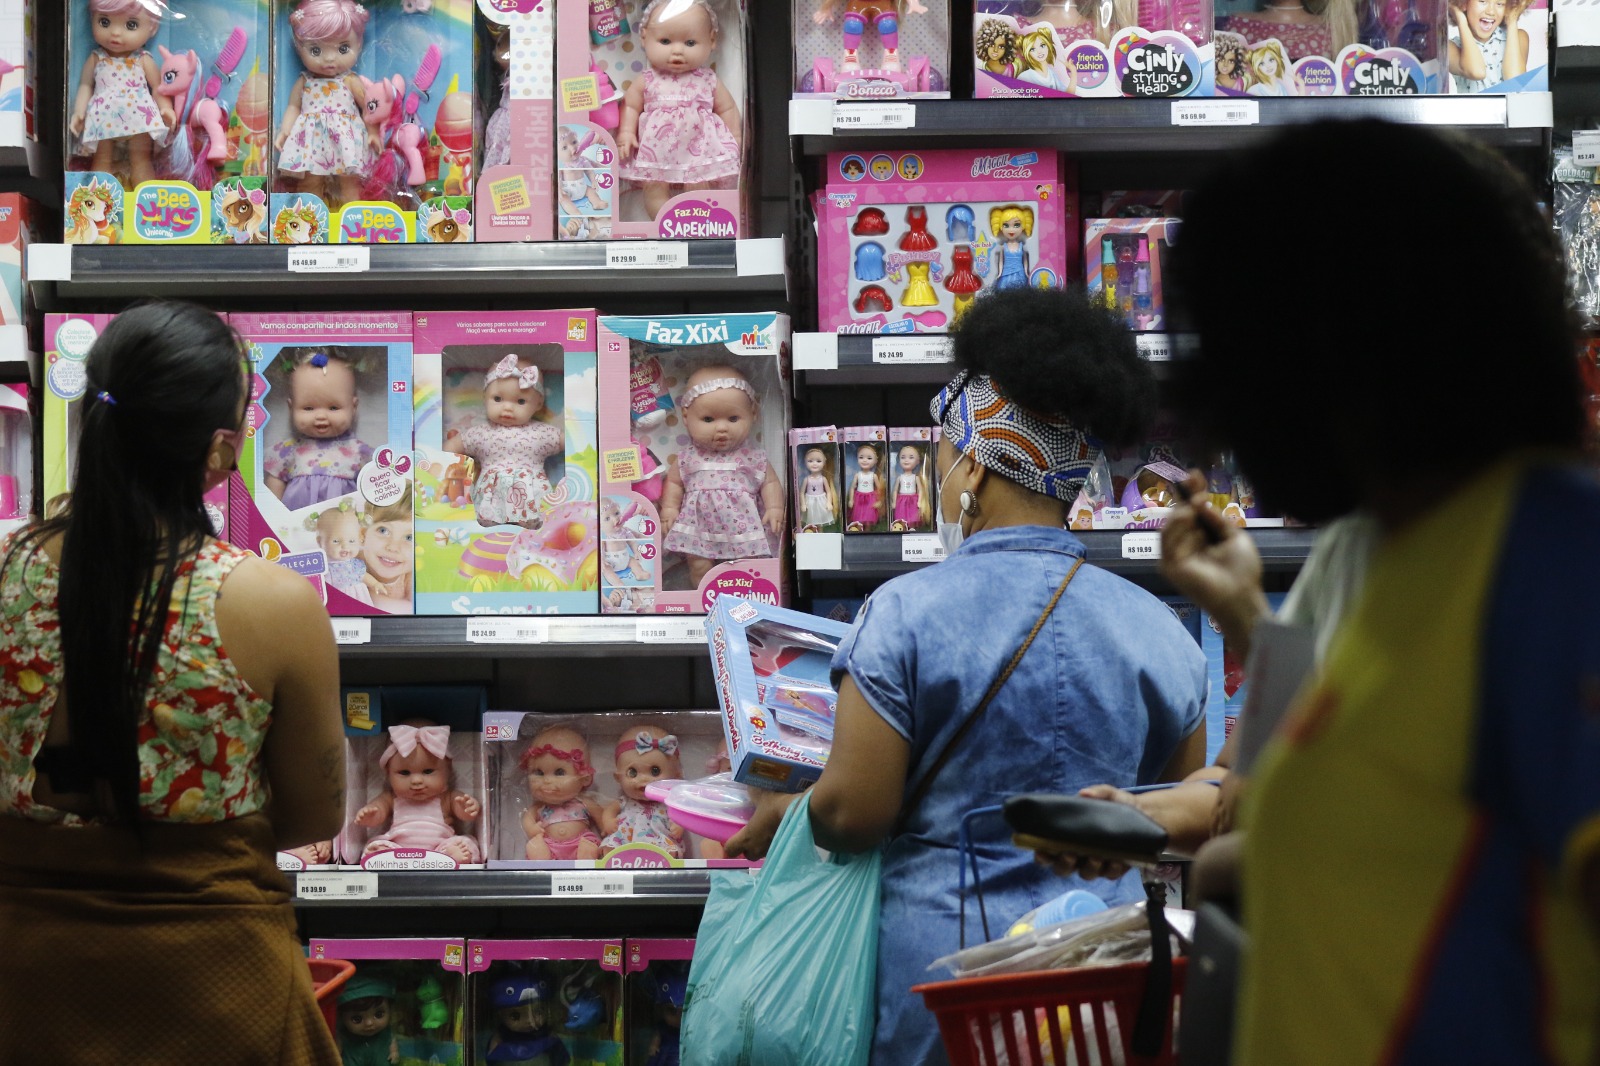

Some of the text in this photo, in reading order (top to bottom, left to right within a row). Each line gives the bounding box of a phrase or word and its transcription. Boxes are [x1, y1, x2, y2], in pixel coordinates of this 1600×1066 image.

[1077, 52, 1104, 62] friends
[1076, 61, 1104, 71] fashion
[1305, 67, 1331, 76] friends
[1304, 75, 1332, 84] fashion
[847, 83, 898, 98] Boneca
[993, 165, 1032, 178] moda
[157, 188, 191, 209] Bee
[347, 213, 362, 221] The
[674, 208, 691, 217] Faz
[692, 207, 711, 217] Xixi
[361, 209, 396, 229] Bee
[260, 321, 399, 331] Vamos compartilhar lindos momentos
[646, 319, 730, 344] Faz Xixi
[609, 343, 620, 351] 3+
[393, 382, 406, 391] 3+
[370, 471, 391, 483] Quero
[375, 478, 390, 488] ficar
[384, 482, 397, 491] seu
[717, 578, 753, 588] Faz Xixi
[751, 735, 801, 757] Bethany
[367, 860, 454, 869] Milkinhas Clássicas
